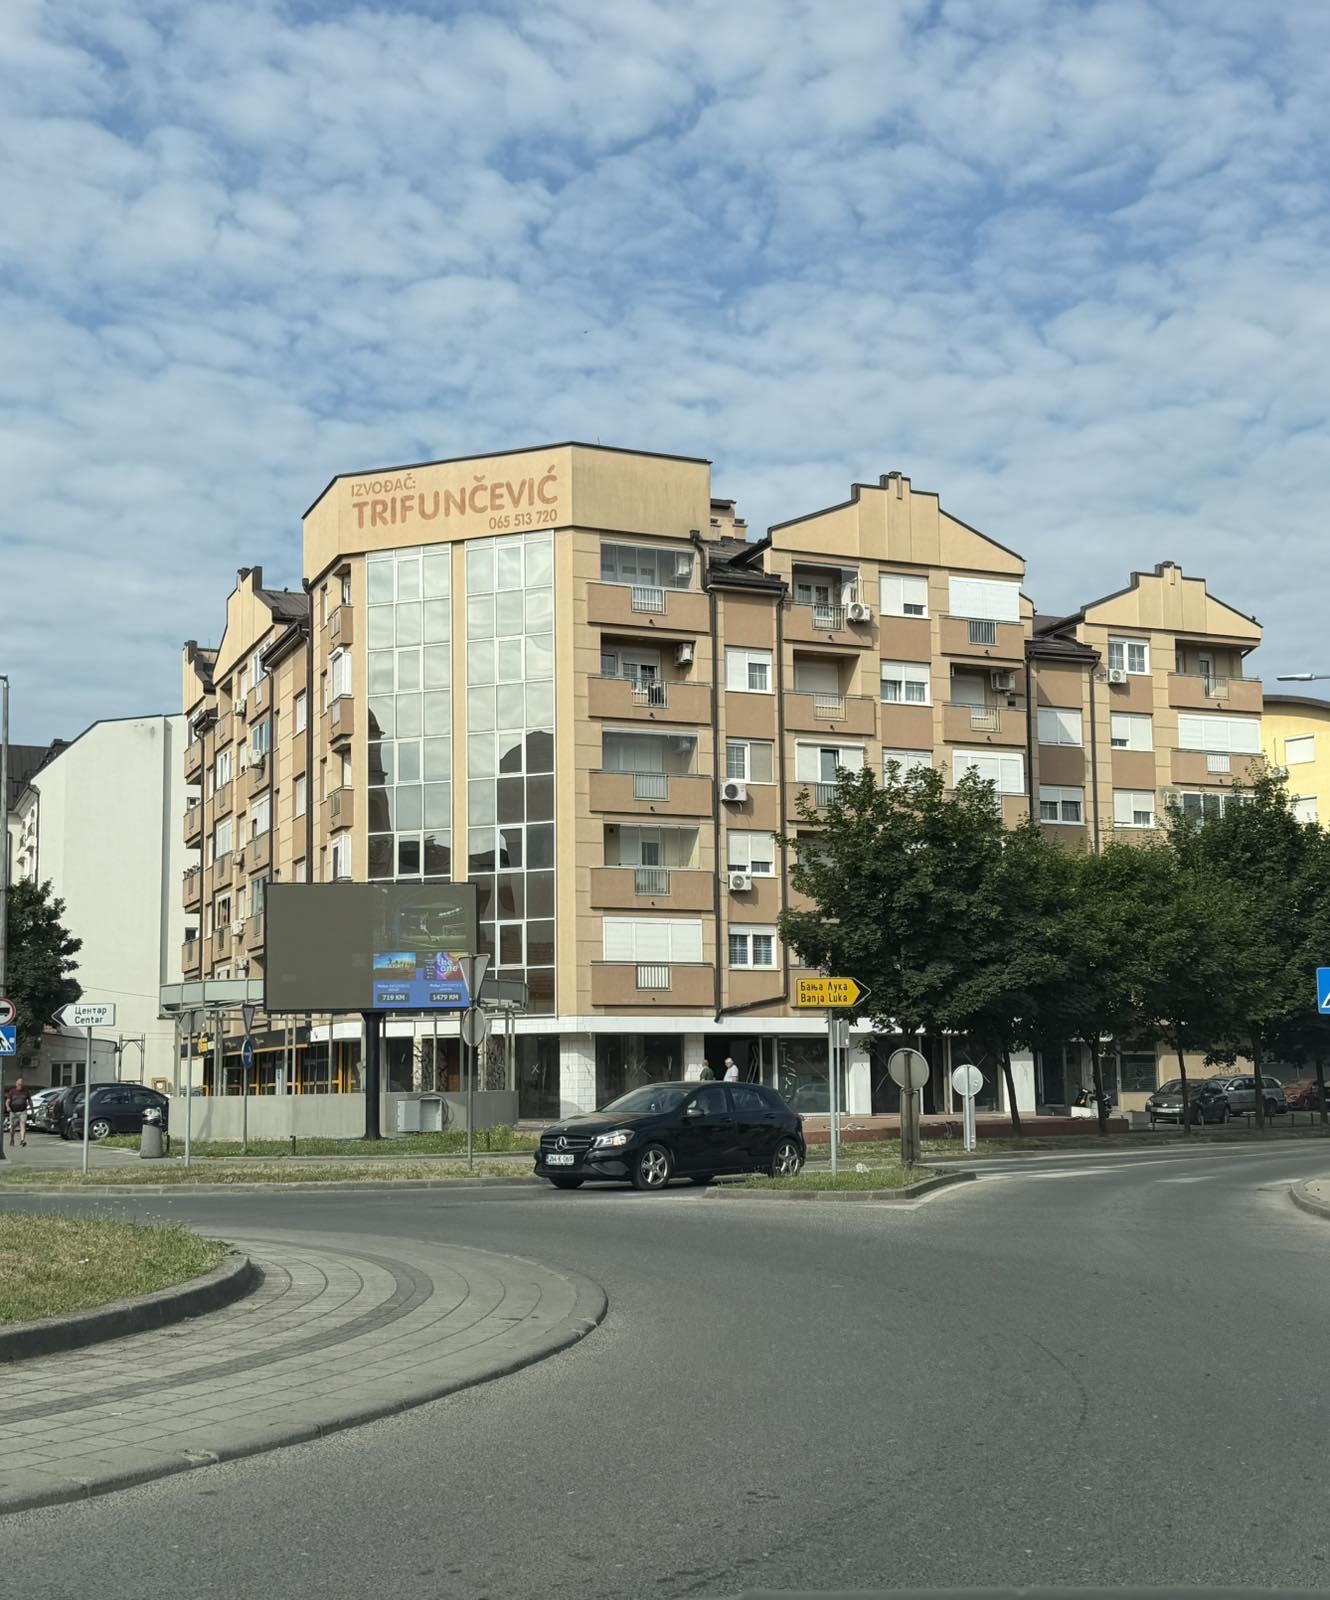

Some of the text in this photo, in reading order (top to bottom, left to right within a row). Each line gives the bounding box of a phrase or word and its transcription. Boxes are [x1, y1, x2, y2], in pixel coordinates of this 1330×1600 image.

[351, 473, 416, 498] IZVOĐAČ:
[352, 464, 558, 529] TRIFUNČEVIĆ
[489, 509, 558, 530] 065 513 720
[800, 981, 848, 993] Бања Лука
[800, 993, 848, 1004] Banja Luka
[74, 1006, 107, 1016] Центар
[74, 1016, 104, 1024] Centar
